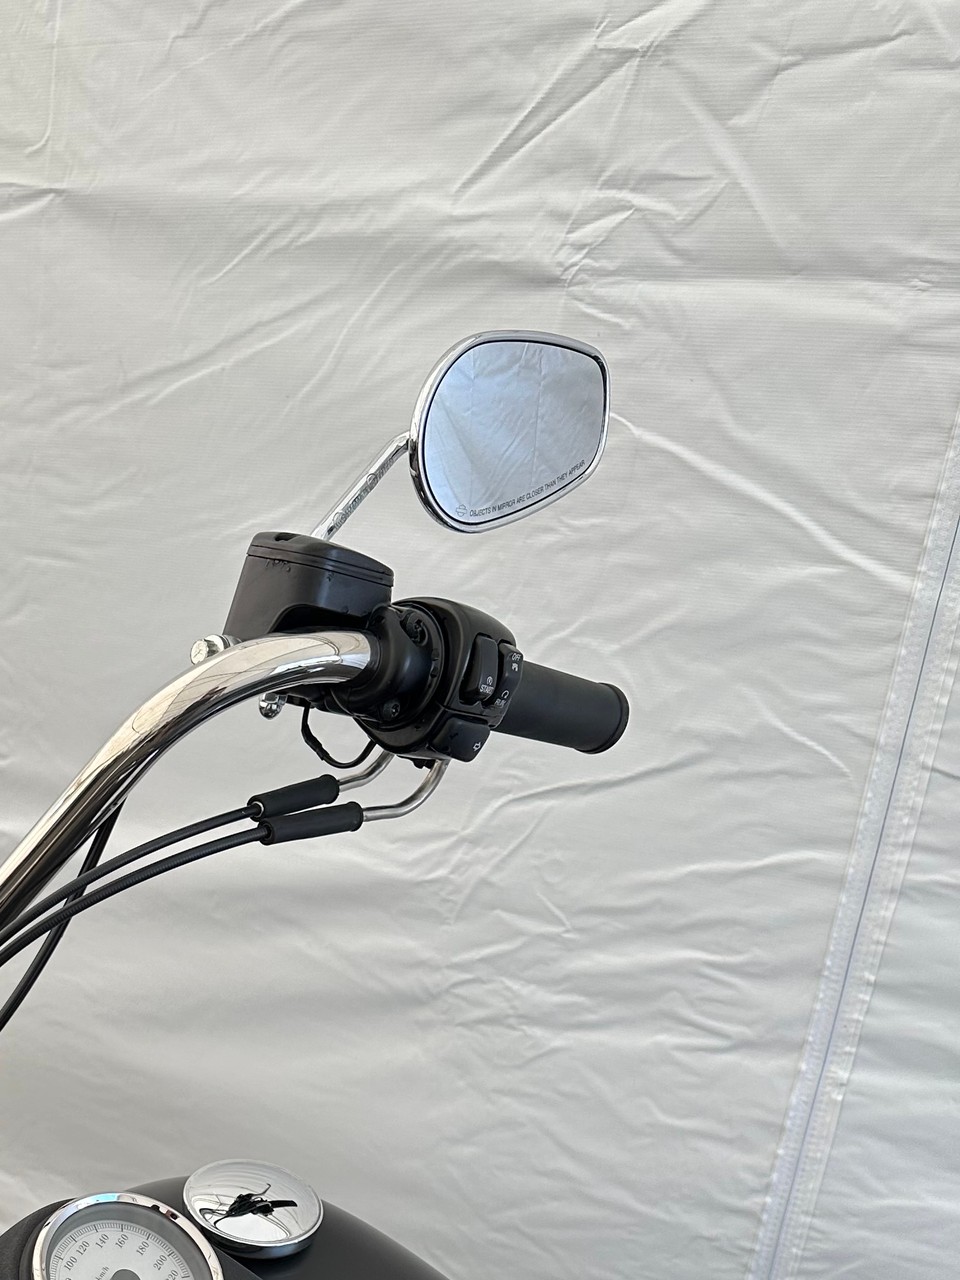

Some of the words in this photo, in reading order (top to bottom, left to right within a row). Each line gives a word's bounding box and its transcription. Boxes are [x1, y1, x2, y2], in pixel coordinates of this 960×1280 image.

[469, 506, 491, 517] OBJECTS
[498, 499, 515, 511] MIRROR
[516, 494, 526, 504] ARE
[526, 486, 544, 499] CLOSER
[545, 480, 557, 491] THAN
[557, 472, 568, 483] THEY
[568, 459, 585, 476] APPEAR
[76, 1240, 90, 1256] 120
[95, 1233, 110, 1250] 140
[115, 1233, 129, 1250] 160
[136, 1241, 150, 1257] 180
[64, 1255, 78, 1272] 100
[153, 1254, 168, 1271] 200
